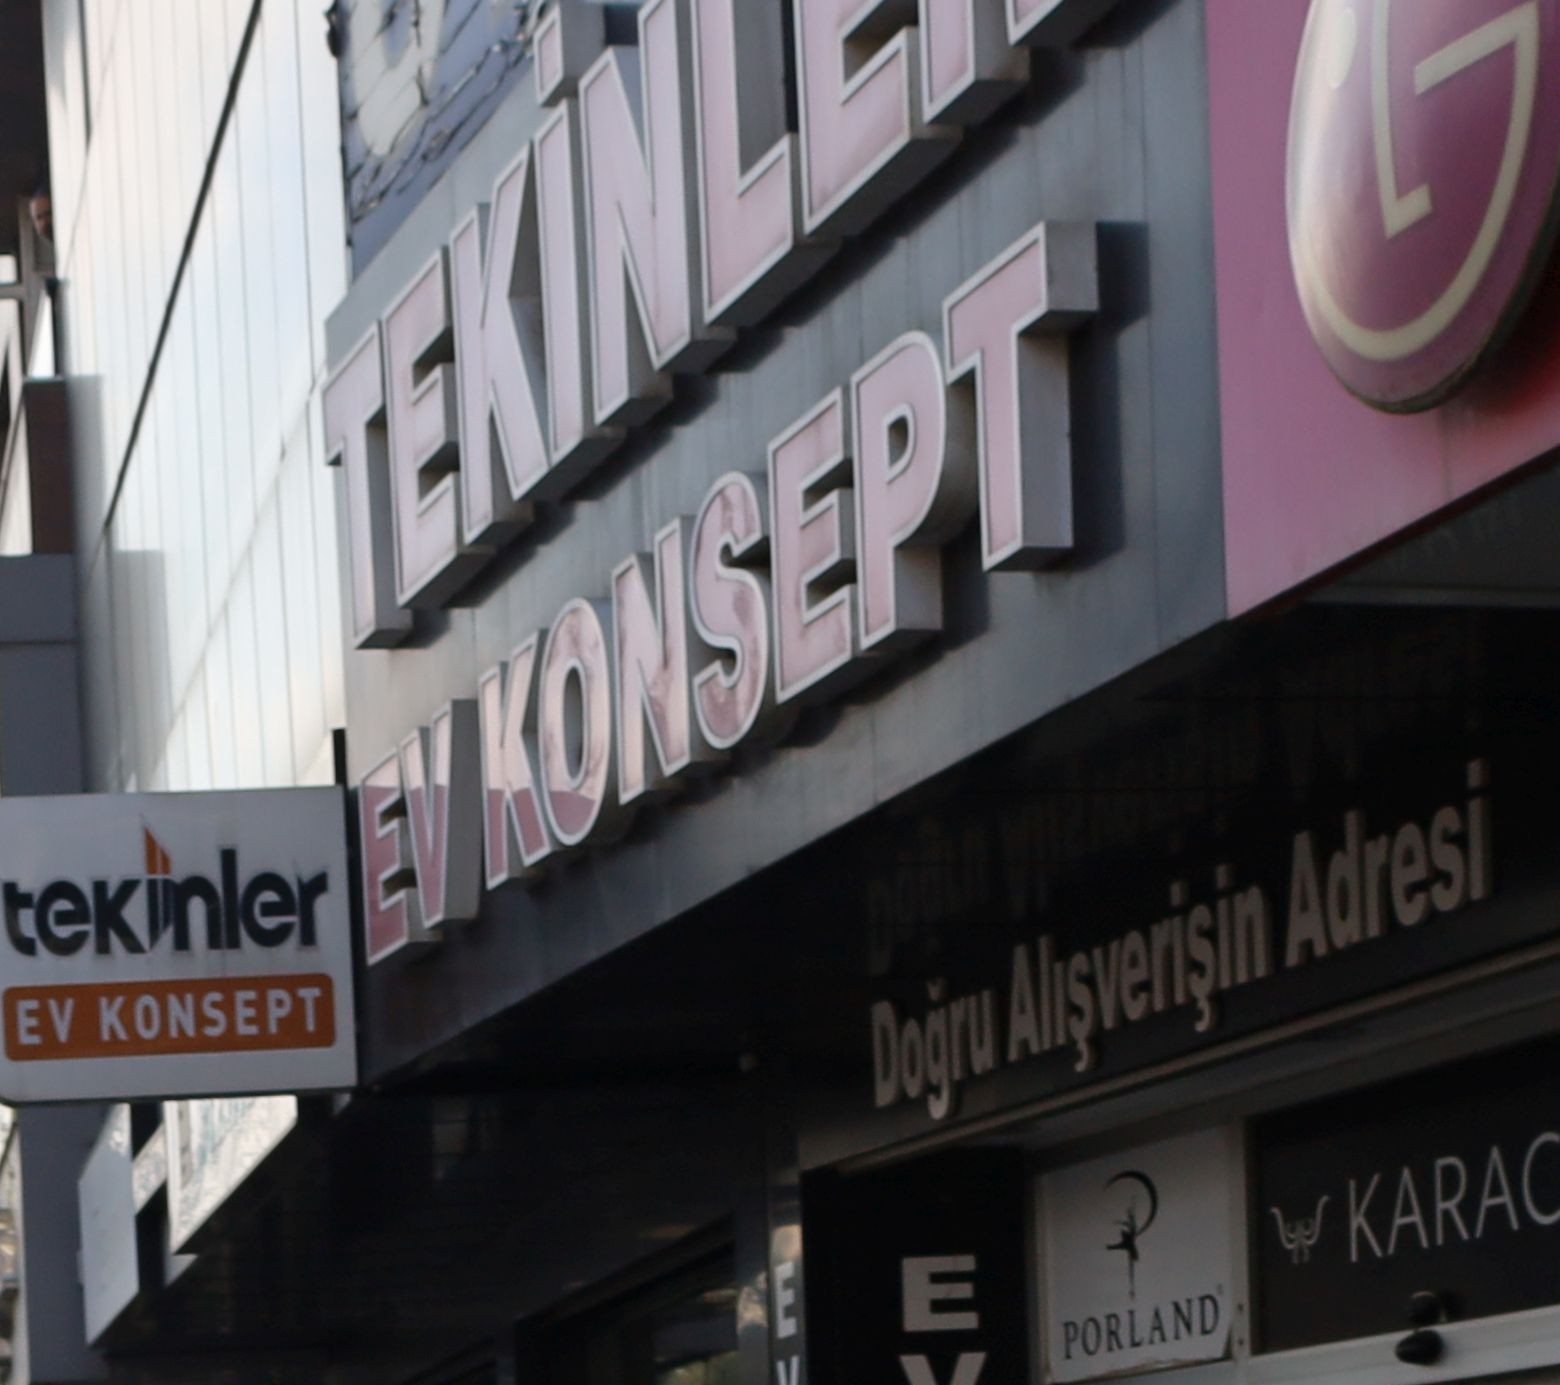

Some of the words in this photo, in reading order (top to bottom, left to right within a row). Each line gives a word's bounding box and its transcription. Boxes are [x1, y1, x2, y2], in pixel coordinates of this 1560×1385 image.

[358, 698, 476, 966] EV
[480, 220, 1098, 890] KONSEPT
[2, 826, 329, 957] tekinler
[870, 976, 999, 1121] Doğru
[1005, 866, 1274, 1074] Alışverişin
[1285, 757, 1493, 970] Adresi
[15, 996, 77, 1046] EV
[97, 985, 323, 1043] KONSEPT
[1062, 1293, 1221, 1361] PORLAND
